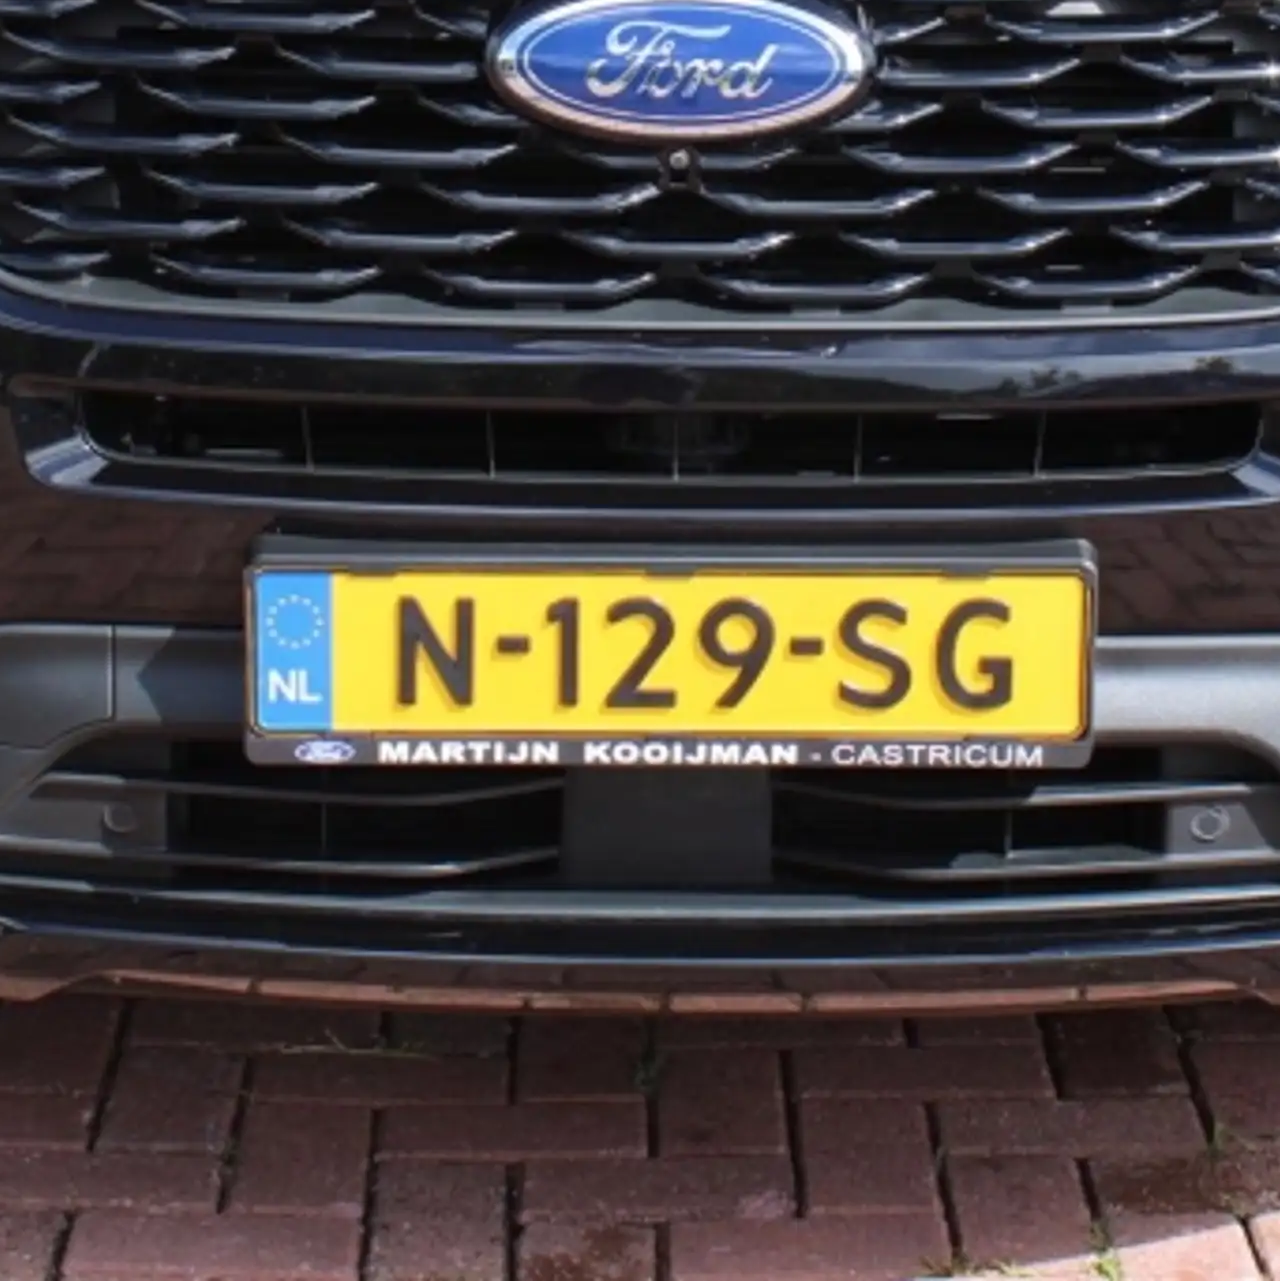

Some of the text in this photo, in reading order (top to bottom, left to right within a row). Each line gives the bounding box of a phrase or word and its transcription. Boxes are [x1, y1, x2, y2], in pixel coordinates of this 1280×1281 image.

[585, 19, 782, 100] Ford
[393, 594, 1016, 710] N-129-SG
[266, 668, 323, 704] NL
[377, 741, 560, 765] MARTIJN
[583, 742, 799, 766] KOOIJMAN
[830, 743, 1044, 768] CASTRICUM
